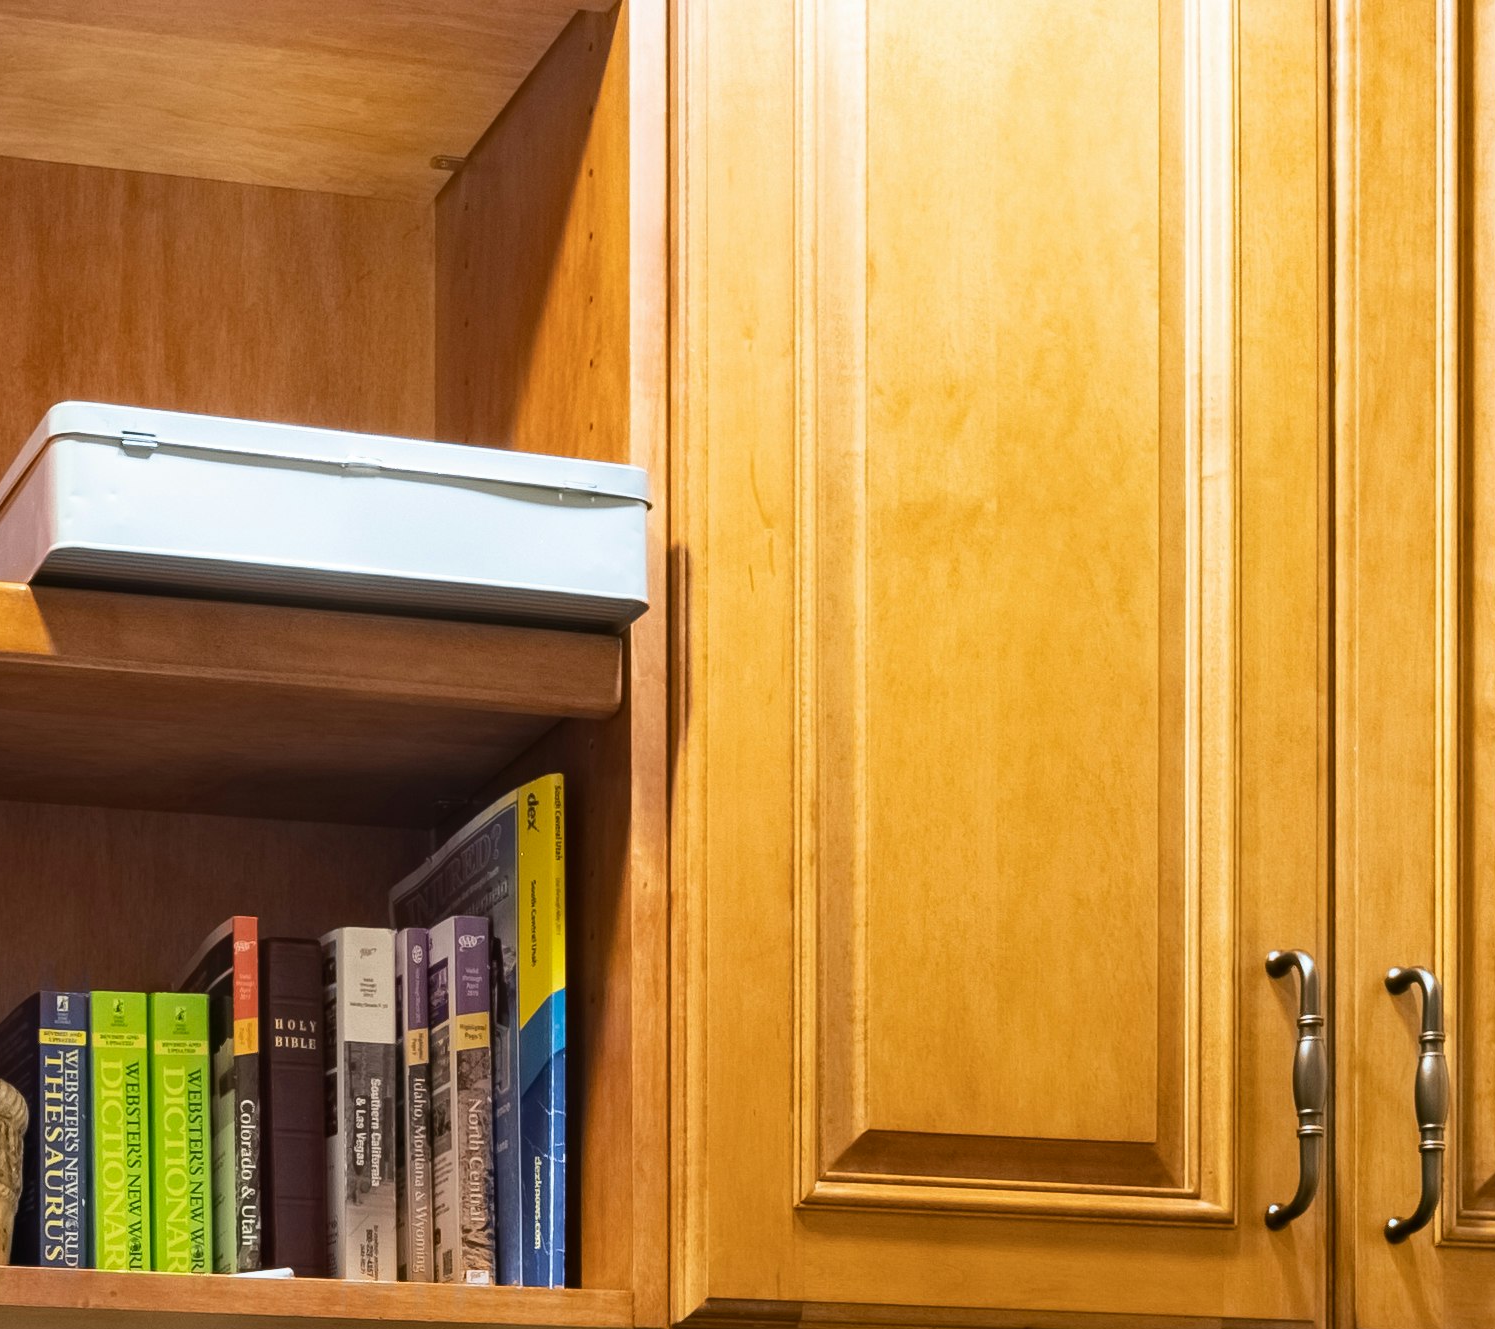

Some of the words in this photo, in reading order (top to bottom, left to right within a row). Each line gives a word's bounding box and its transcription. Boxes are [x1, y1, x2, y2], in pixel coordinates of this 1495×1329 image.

[527, 792, 540, 833] dex
[554, 785, 562, 814] South
[554, 816, 562, 841] Central
[274, 1018, 317, 1033] HOLY
[274, 1035, 317, 1050] BIBLE
[64, 1049, 79, 1152] WEBSTER'S
[125, 1061, 142, 1169] WEBSTER'S
[355, 1110, 367, 1129] Las
[370, 1078, 381, 1130] Southern
[412, 1077, 428, 1121] Idaho,
[188, 1068, 204, 1176] WEBSTER'S
[240, 1099, 257, 1184] Colorado
[467, 1098, 484, 1151] North
[45, 1051, 64, 1261] THESAURUS
[100, 1059, 127, 1271] DICTIONAR
[163, 1065, 190, 1273] DICTIONAR
[354, 1132, 367, 1167] Vegas
[371, 1132, 382, 1187] California
[411, 1123, 428, 1188] Montana
[64, 1157, 79, 1197] NEW
[126, 1174, 142, 1217] NEW
[241, 1186, 256, 1199] &
[414, 1191, 426, 1201] &
[468, 1157, 486, 1228] Central
[189, 1181, 204, 1224] NEW
[241, 1206, 257, 1247] Utah
[412, 1203, 428, 1273] Wyoming
